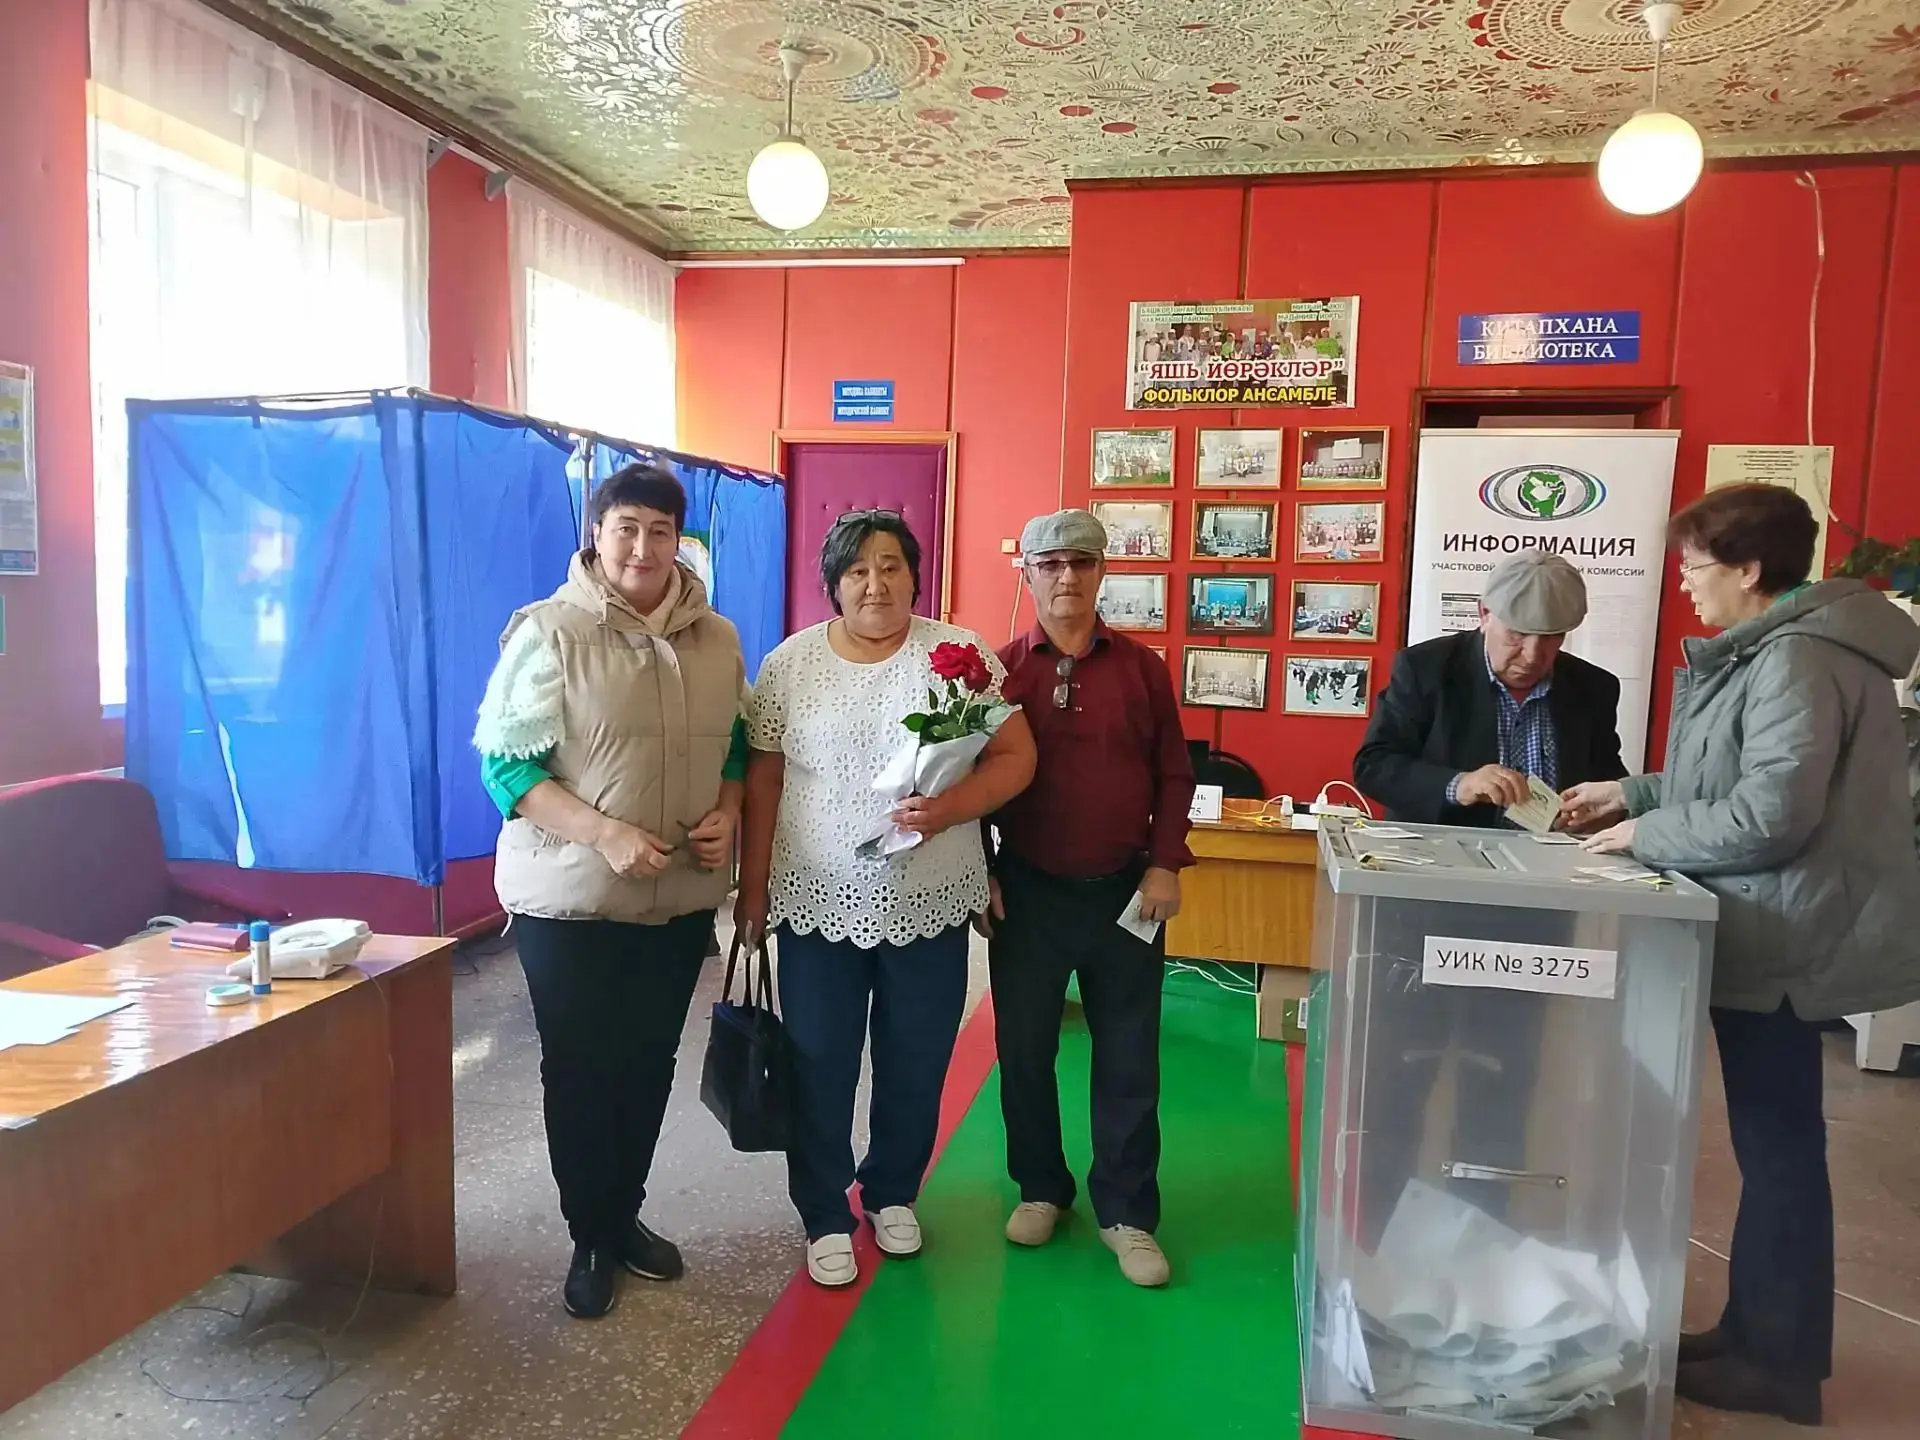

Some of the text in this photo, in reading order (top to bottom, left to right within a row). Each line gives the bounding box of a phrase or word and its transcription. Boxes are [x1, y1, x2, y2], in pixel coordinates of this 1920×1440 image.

[1481, 317, 1618, 337] КИТАПХАНА
[1473, 342, 1616, 360] БИБЛИОТЕКА
[1143, 386, 1337, 403] ФОЛЬКЛОР АНСАМБЛЕ
[1443, 533, 1636, 559] ИНФОРМАЦИЯ
[1587, 567, 1645, 576] КОМИССИИ
[1437, 949, 1590, 979] УИК № 3275
